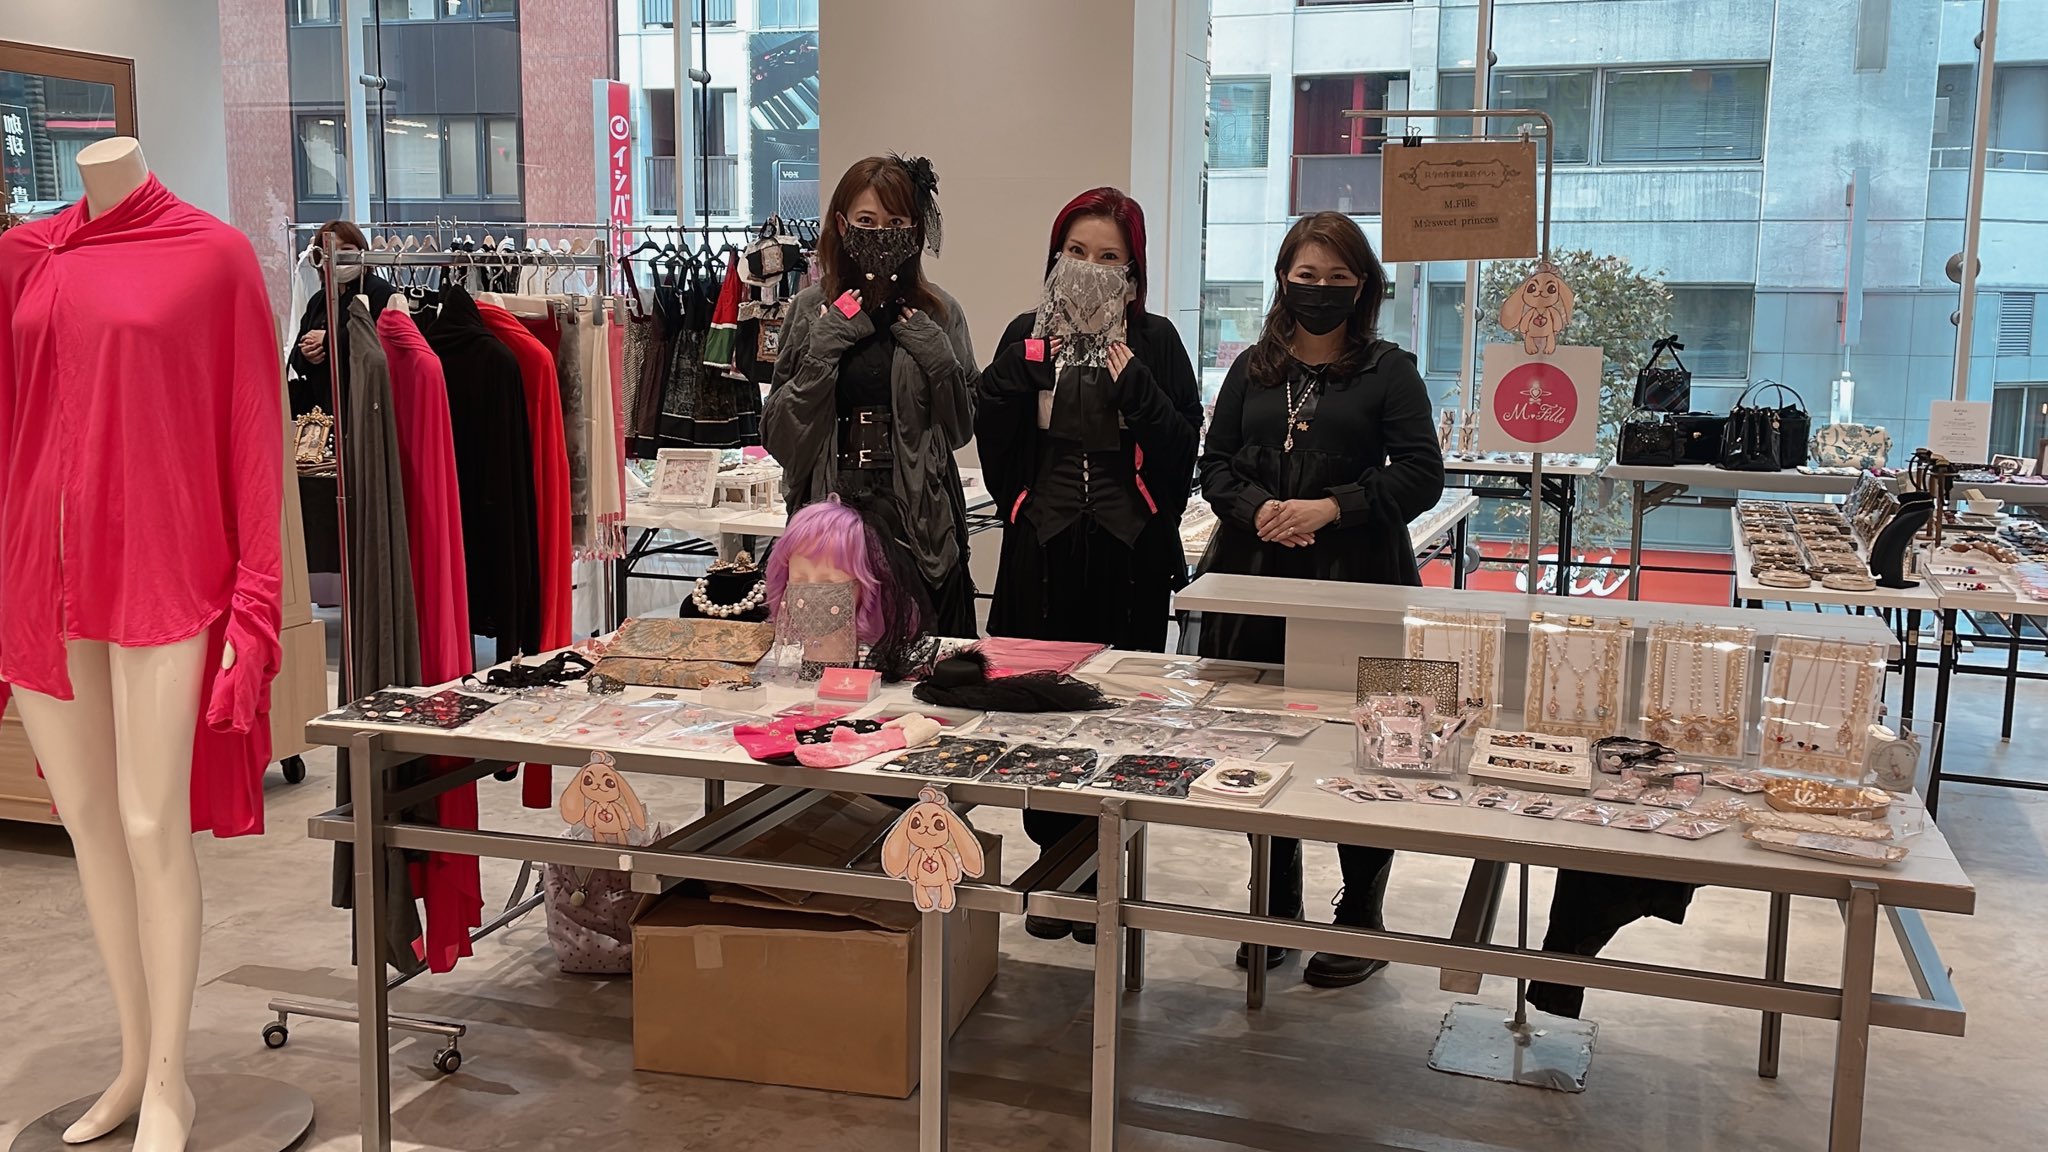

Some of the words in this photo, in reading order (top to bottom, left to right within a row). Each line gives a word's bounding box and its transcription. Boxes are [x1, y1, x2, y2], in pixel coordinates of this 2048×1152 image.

[781, 170, 800, 179] VOX
[1444, 198, 1476, 209] M.Fille
[1461, 215, 1499, 228] princess
